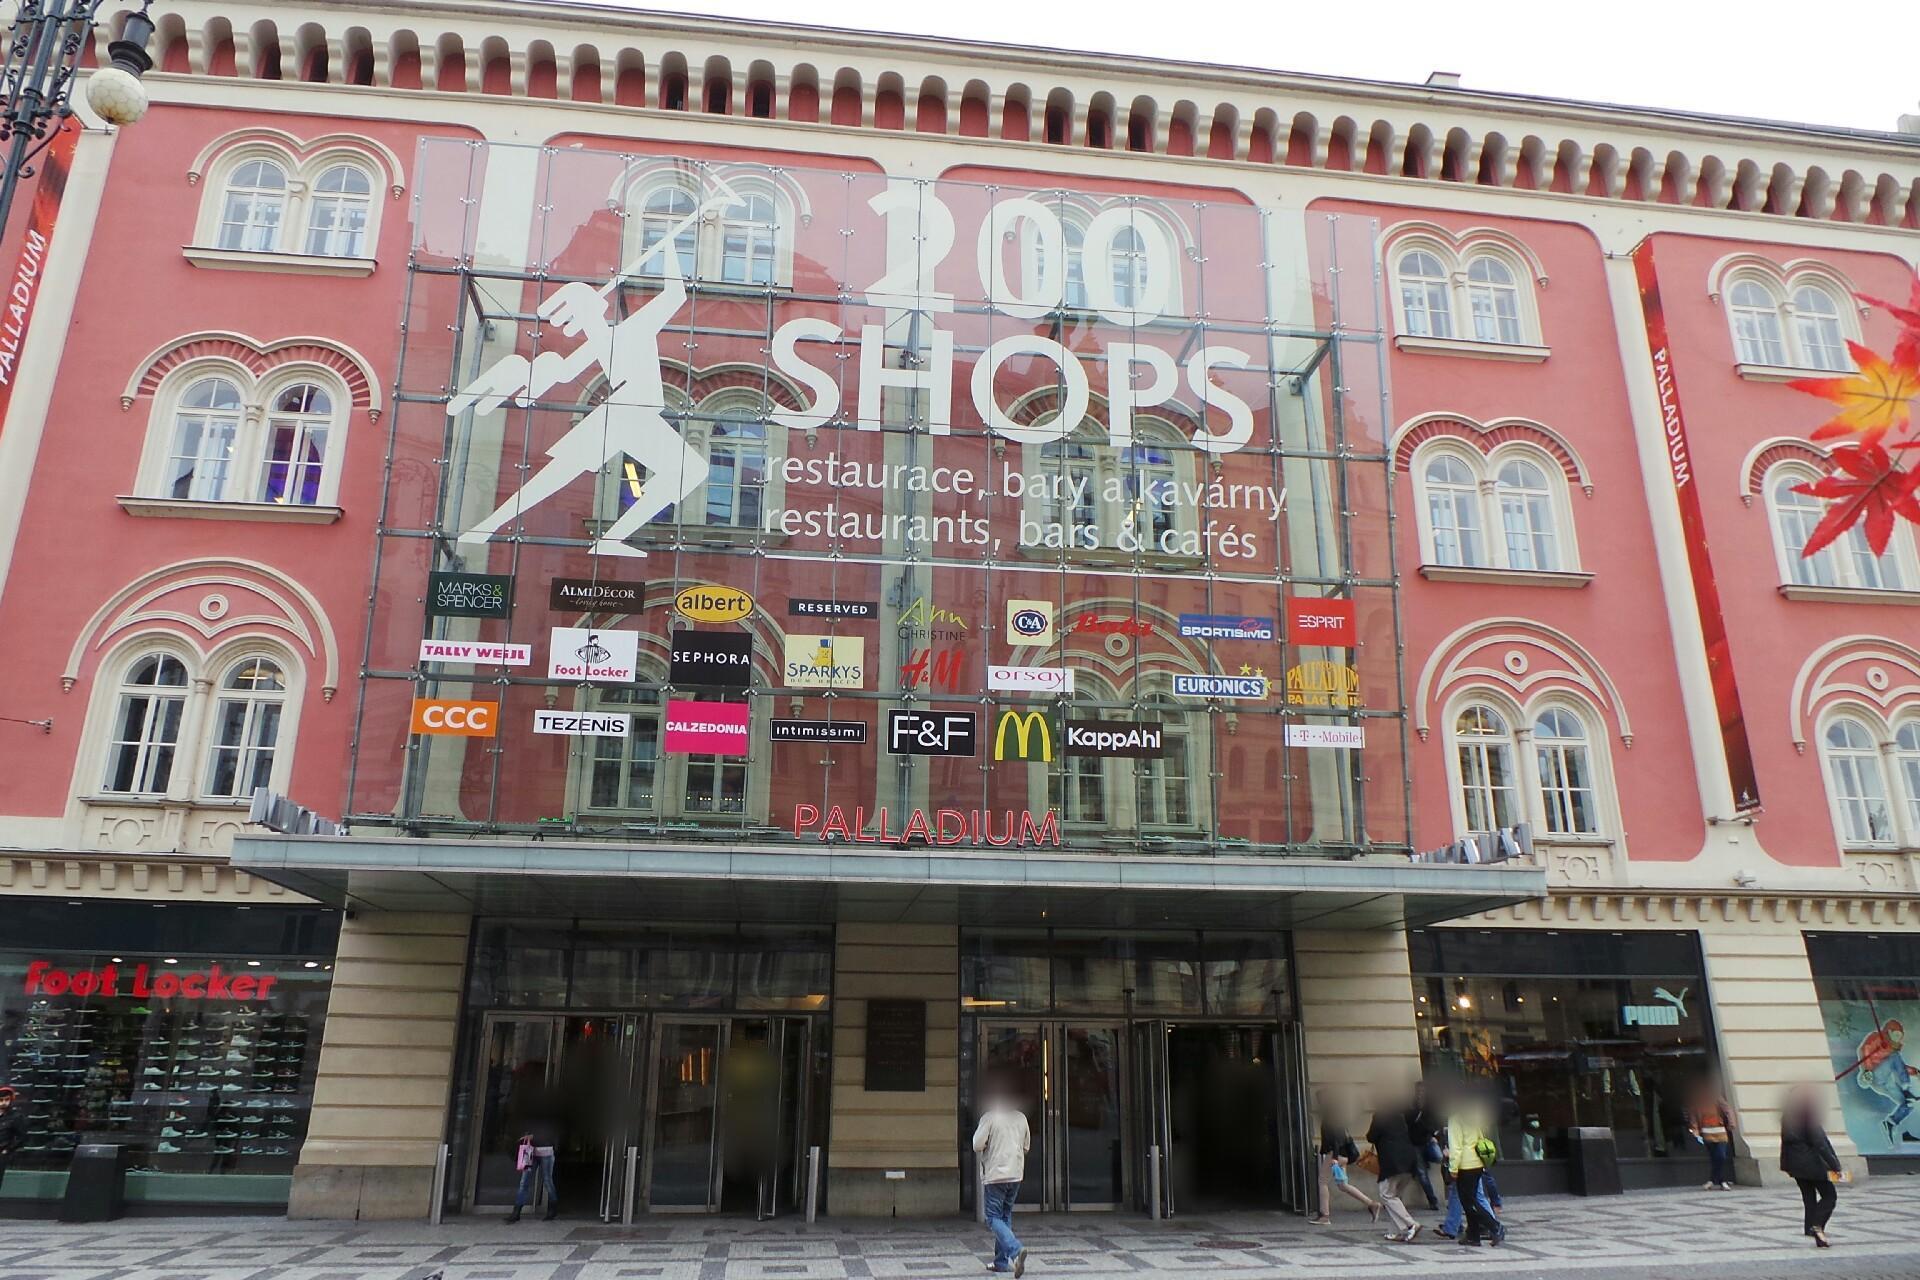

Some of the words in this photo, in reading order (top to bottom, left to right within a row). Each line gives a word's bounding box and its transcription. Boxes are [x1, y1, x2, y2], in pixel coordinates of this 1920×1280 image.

[865, 186, 1168, 326] 200
[769, 317, 1254, 453] SHOPS
[1654, 347, 1690, 487] PALLADIUM
[766, 452, 986, 501] restaurace,
[1002, 461, 1087, 510] bary
[1103, 472, 1127, 501] a
[1140, 467, 1287, 520] kavárny
[765, 504, 1001, 551] restaurants,
[1020, 512, 1099, 551] bars
[1117, 520, 1144, 553] &
[1161, 523, 1257, 558] cafés
[437, 593, 503, 609] SPENCER
[681, 593, 746, 612] albert
[798, 603, 868, 615] RESERVED
[897, 597, 969, 630] Ann
[1017, 616, 1042, 630] C&A
[1298, 614, 1346, 629] ESPRIT
[898, 626, 967, 641] CHRISTINE
[1181, 626, 1271, 640] SPORTISIMO
[425, 645, 472, 657] TALLY
[672, 650, 750, 666] SEPHORA
[555, 664, 582, 677] Foot
[586, 665, 629, 678] Locker
[787, 663, 861, 680] SPARKYS
[899, 648, 966, 690] H&M
[1286, 660, 1361, 692] PALLADIUM
[994, 670, 1067, 690] orsay
[1178, 677, 1264, 697] EURONICS
[422, 705, 489, 731] CCC
[665, 721, 747, 735] CALZEDONIA
[775, 726, 861, 738] intimissimi
[892, 715, 971, 751] F&F
[1067, 727, 1162, 751] KappAhl
[793, 803, 1060, 846] PALLADIUM
[25, 961, 118, 997] Foot
[132, 964, 278, 1000] Locker
